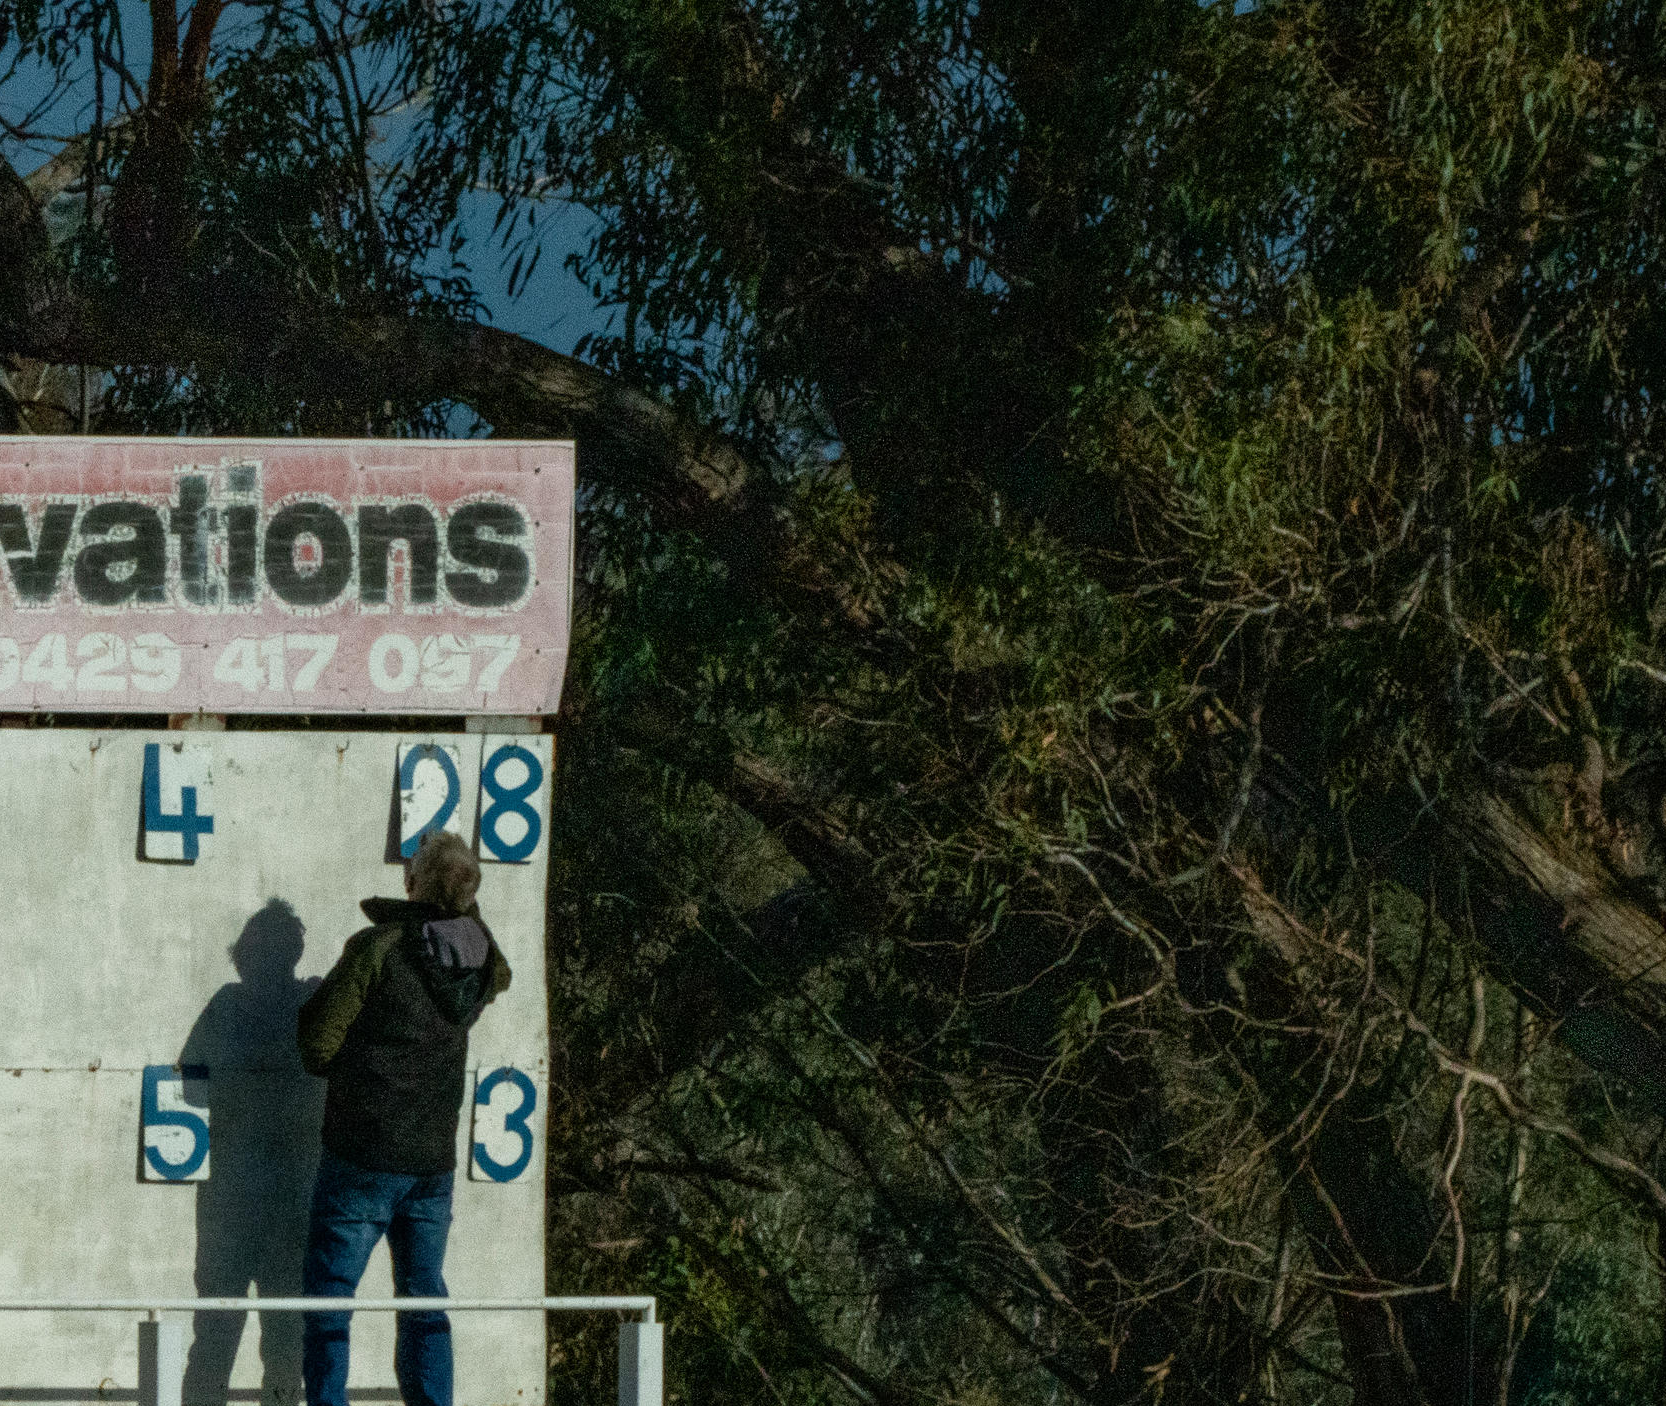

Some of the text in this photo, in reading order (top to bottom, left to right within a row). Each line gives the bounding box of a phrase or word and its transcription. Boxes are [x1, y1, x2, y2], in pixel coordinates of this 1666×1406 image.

[213, 633, 339, 692] 417
[144, 743, 214, 860] 4
[400, 744, 544, 862] 28
[143, 1065, 210, 1180] 5
